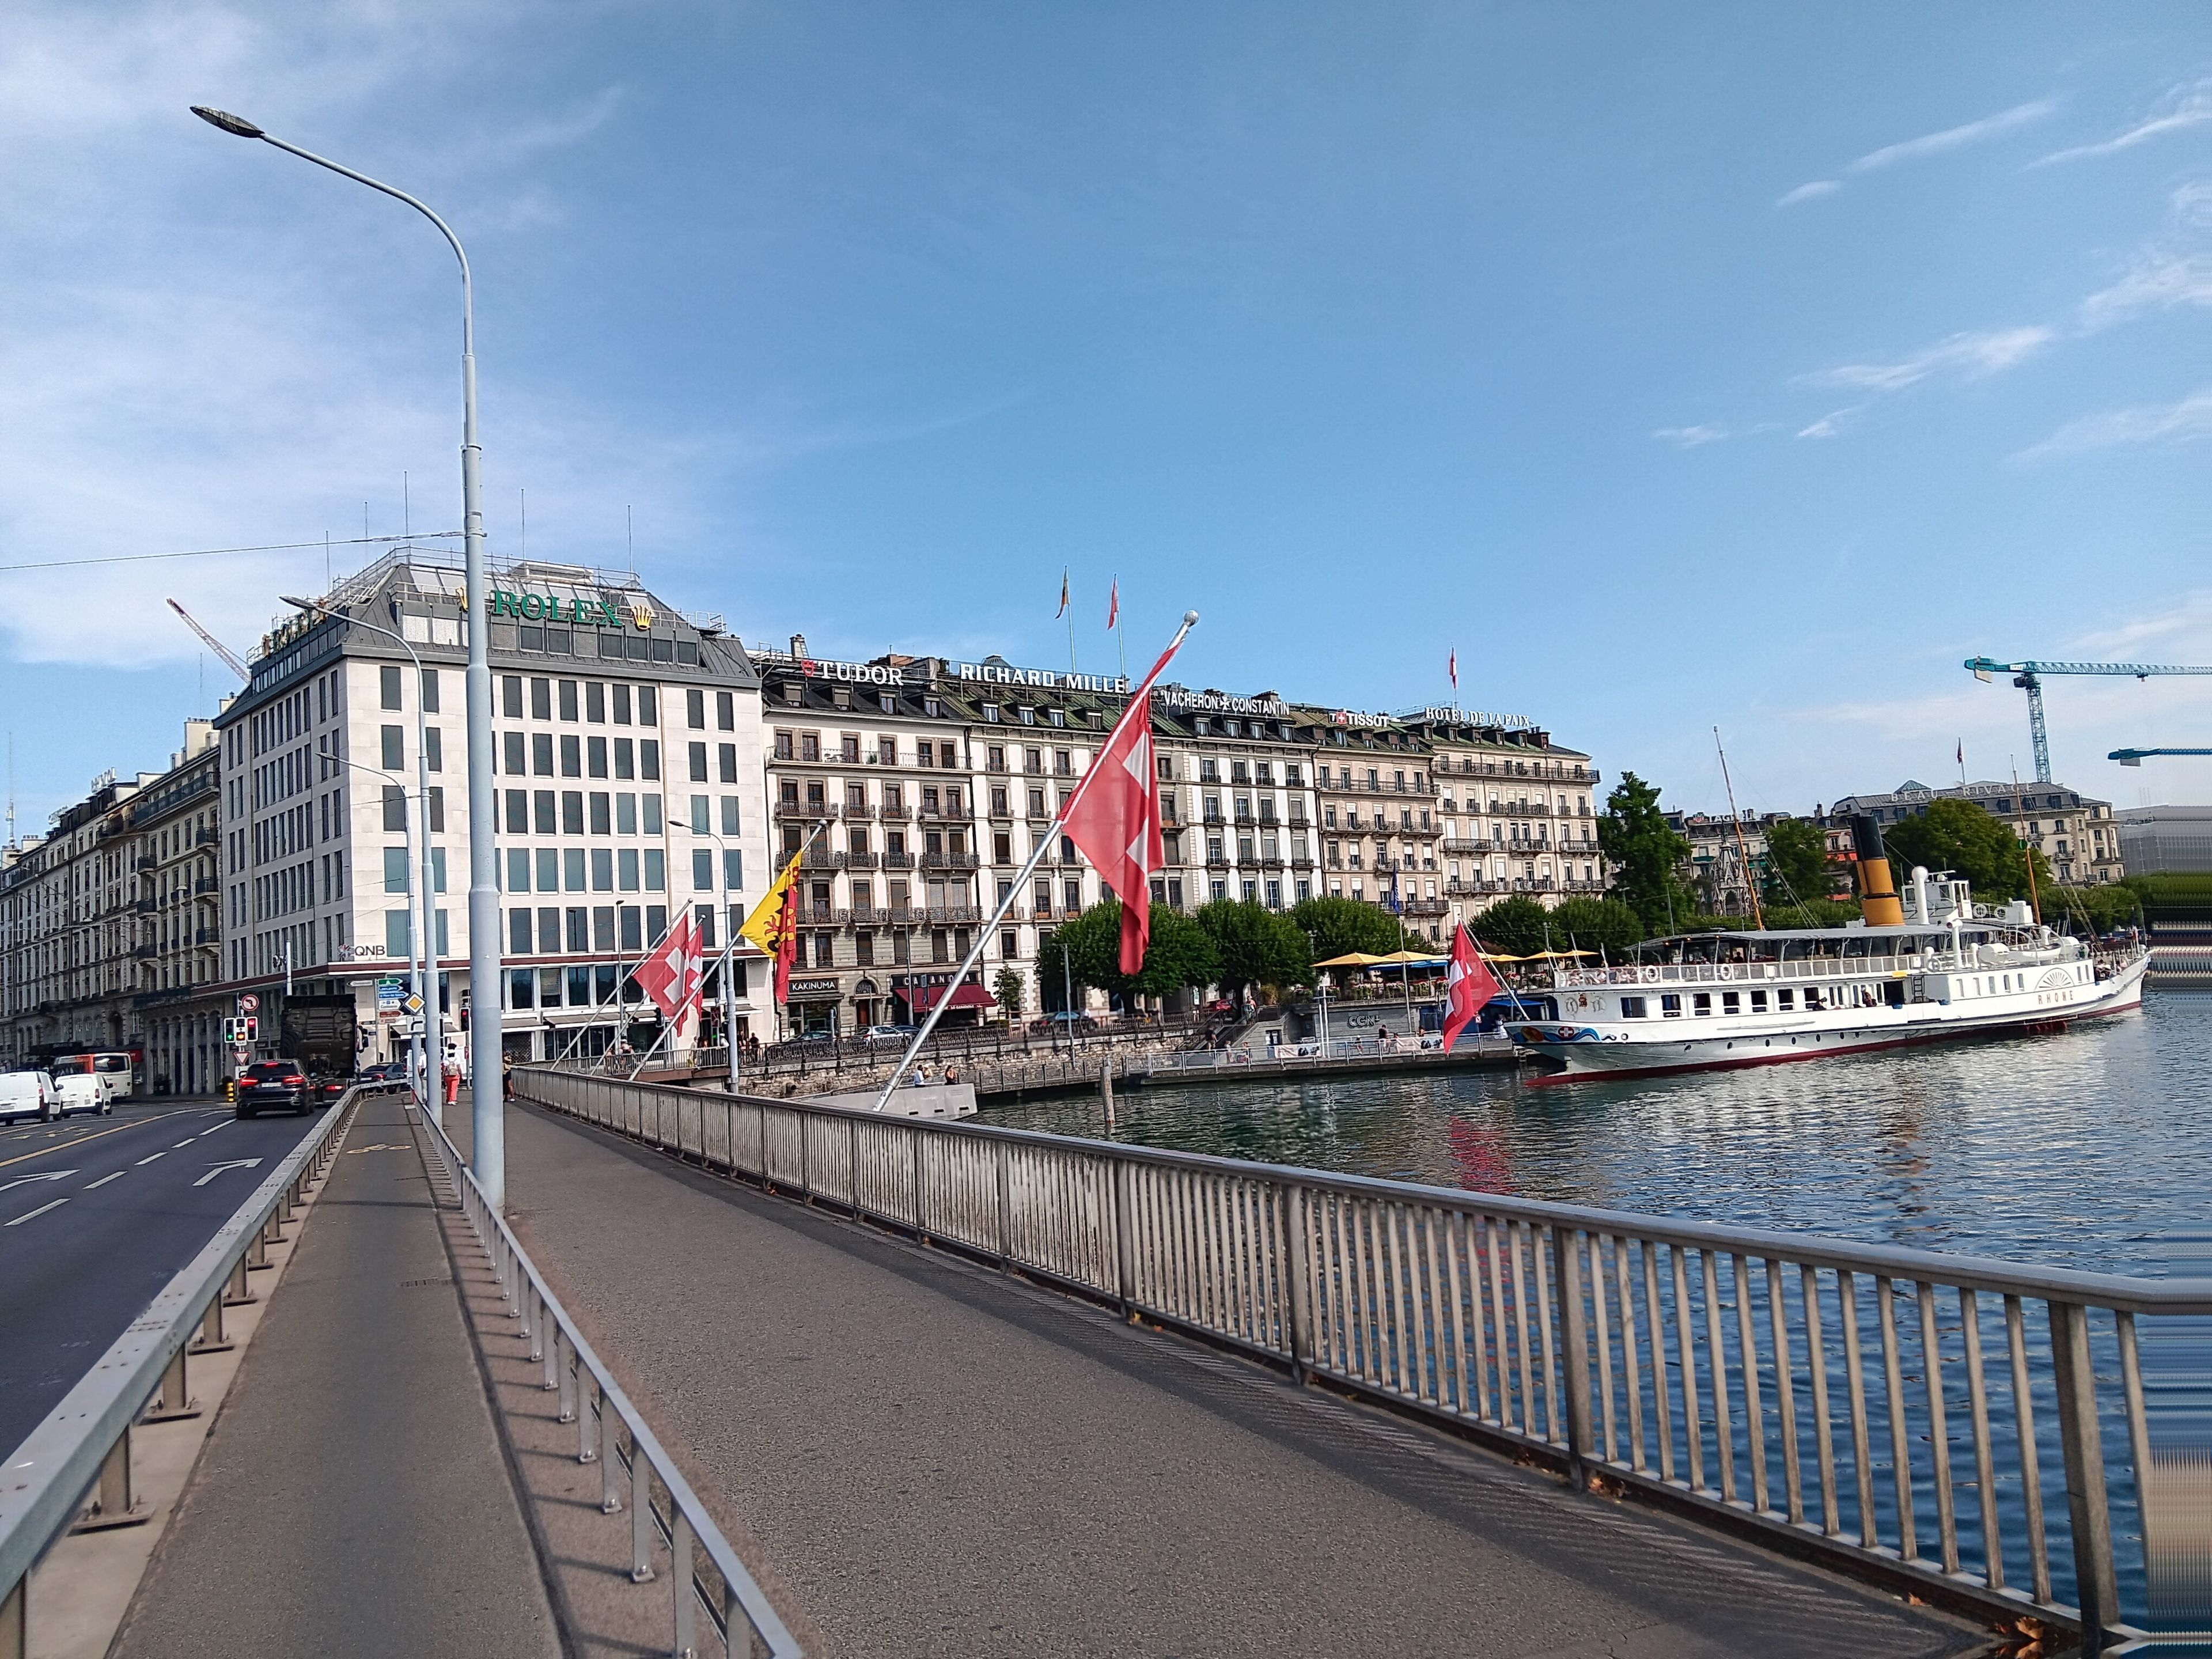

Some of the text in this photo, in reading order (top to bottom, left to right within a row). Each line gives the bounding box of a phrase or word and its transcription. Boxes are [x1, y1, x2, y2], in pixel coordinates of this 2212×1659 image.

[491, 589, 624, 627] ROLEX
[817, 660, 904, 686] TUDOR
[959, 663, 1126, 694] RICHARD MILLE
[1161, 690, 1290, 715] VACHERON CONSTANTIN
[1346, 713, 1389, 728] TISSOT
[1425, 707, 1530, 726] HOTEL DE LA PAIX
[354, 945, 385, 956] QNB
[792, 981, 836, 991] KAKINUMA
[904, 974, 971, 986] CAANOA
[1349, 1014, 1376, 1027] CGN
